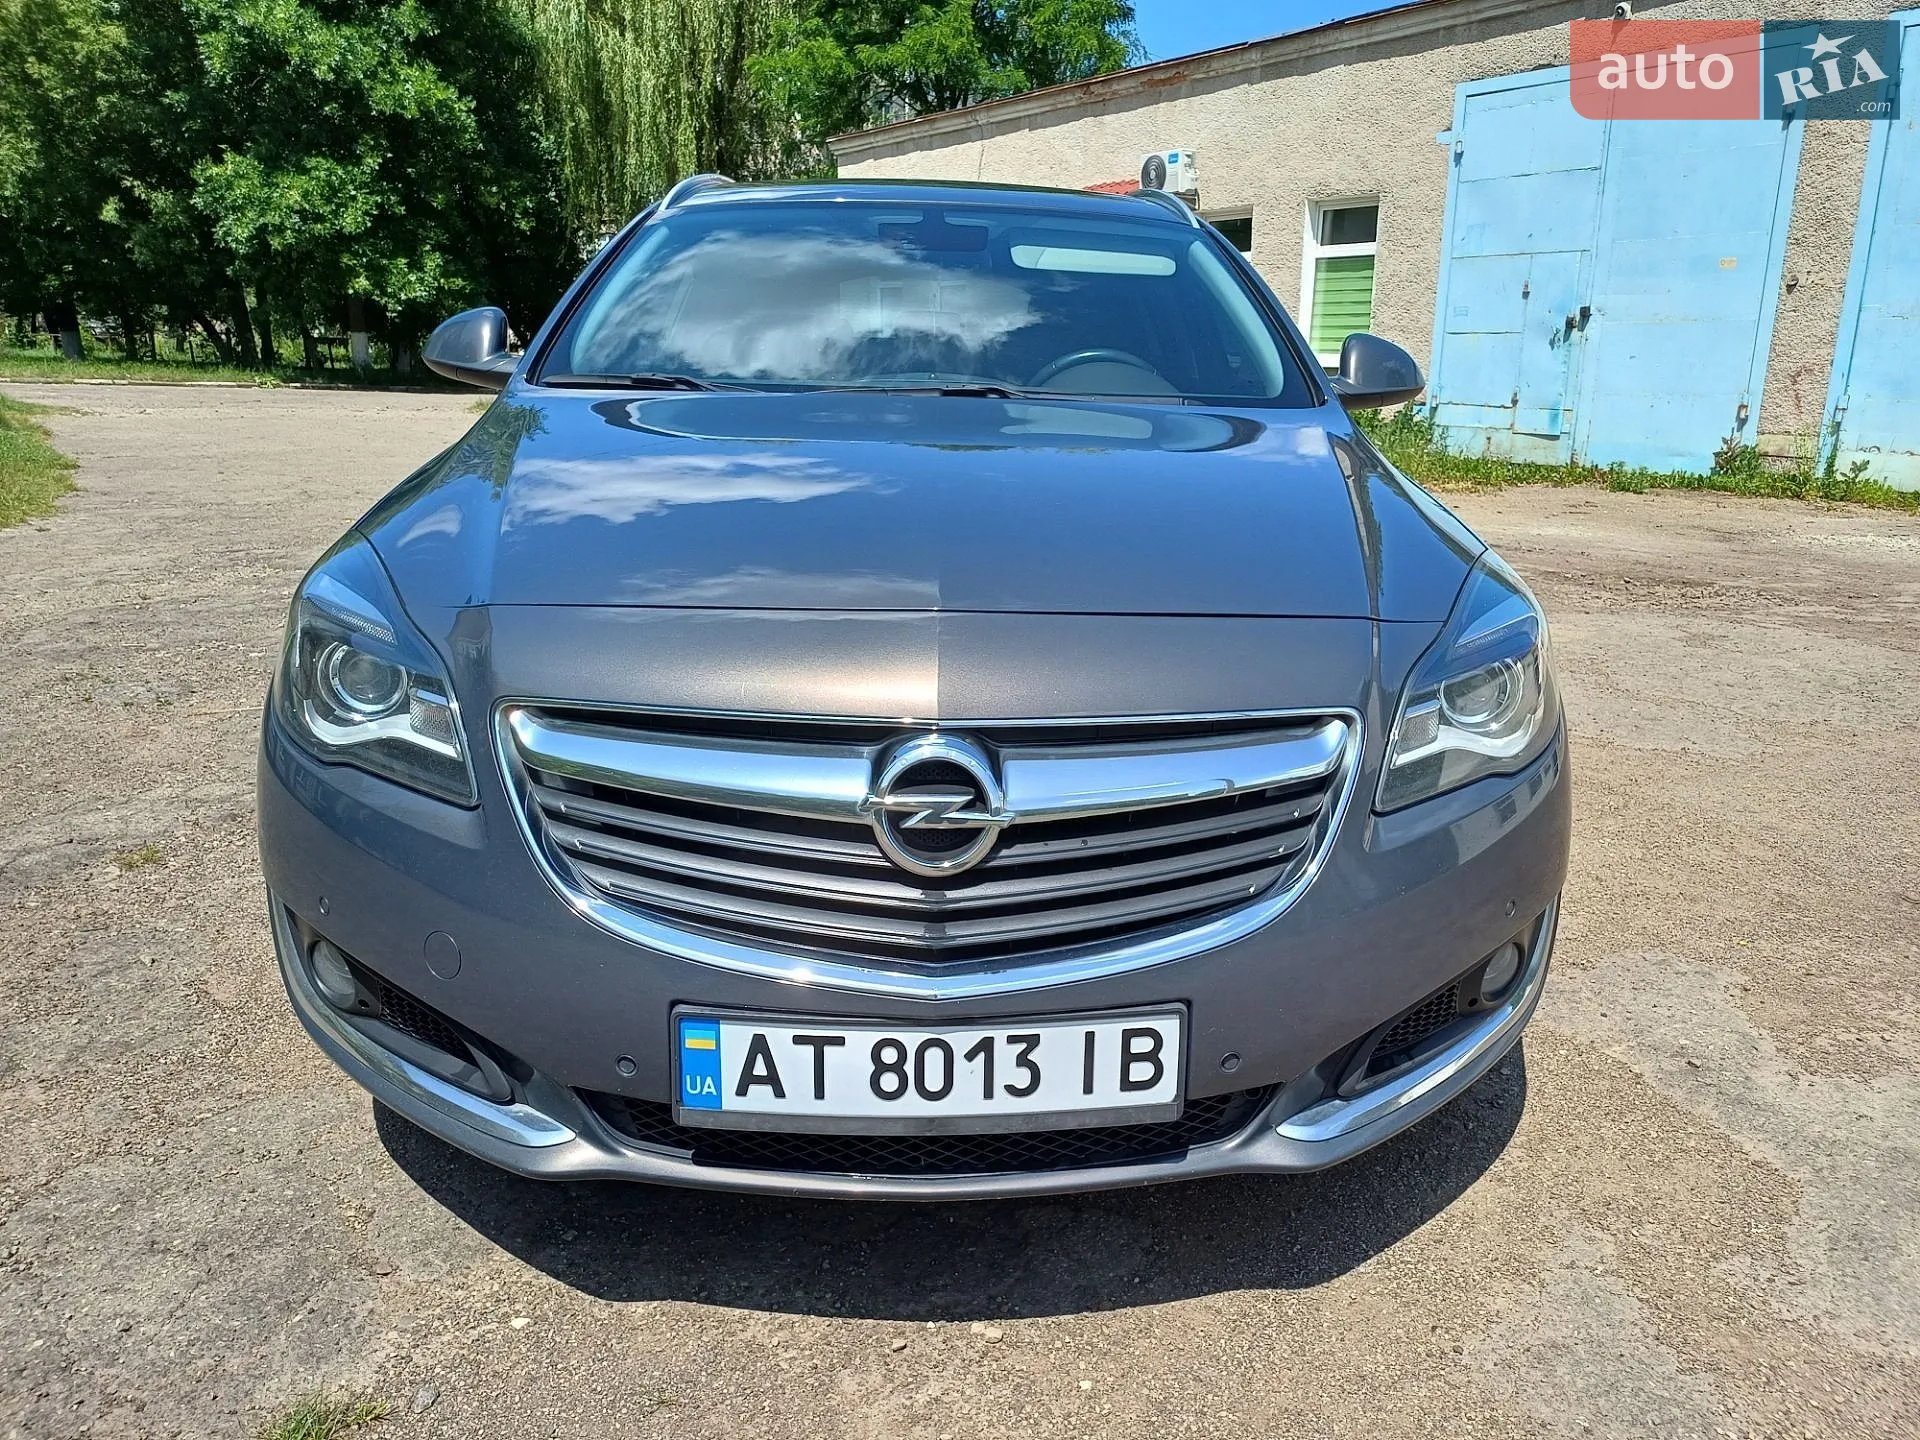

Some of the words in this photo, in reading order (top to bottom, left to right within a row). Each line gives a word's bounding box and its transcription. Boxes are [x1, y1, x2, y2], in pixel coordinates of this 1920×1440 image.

[686, 1074, 717, 1096] UA
[735, 1033, 845, 1099] AT
[869, 1033, 1041, 1101] 8013
[1083, 1026, 1164, 1095] IB
